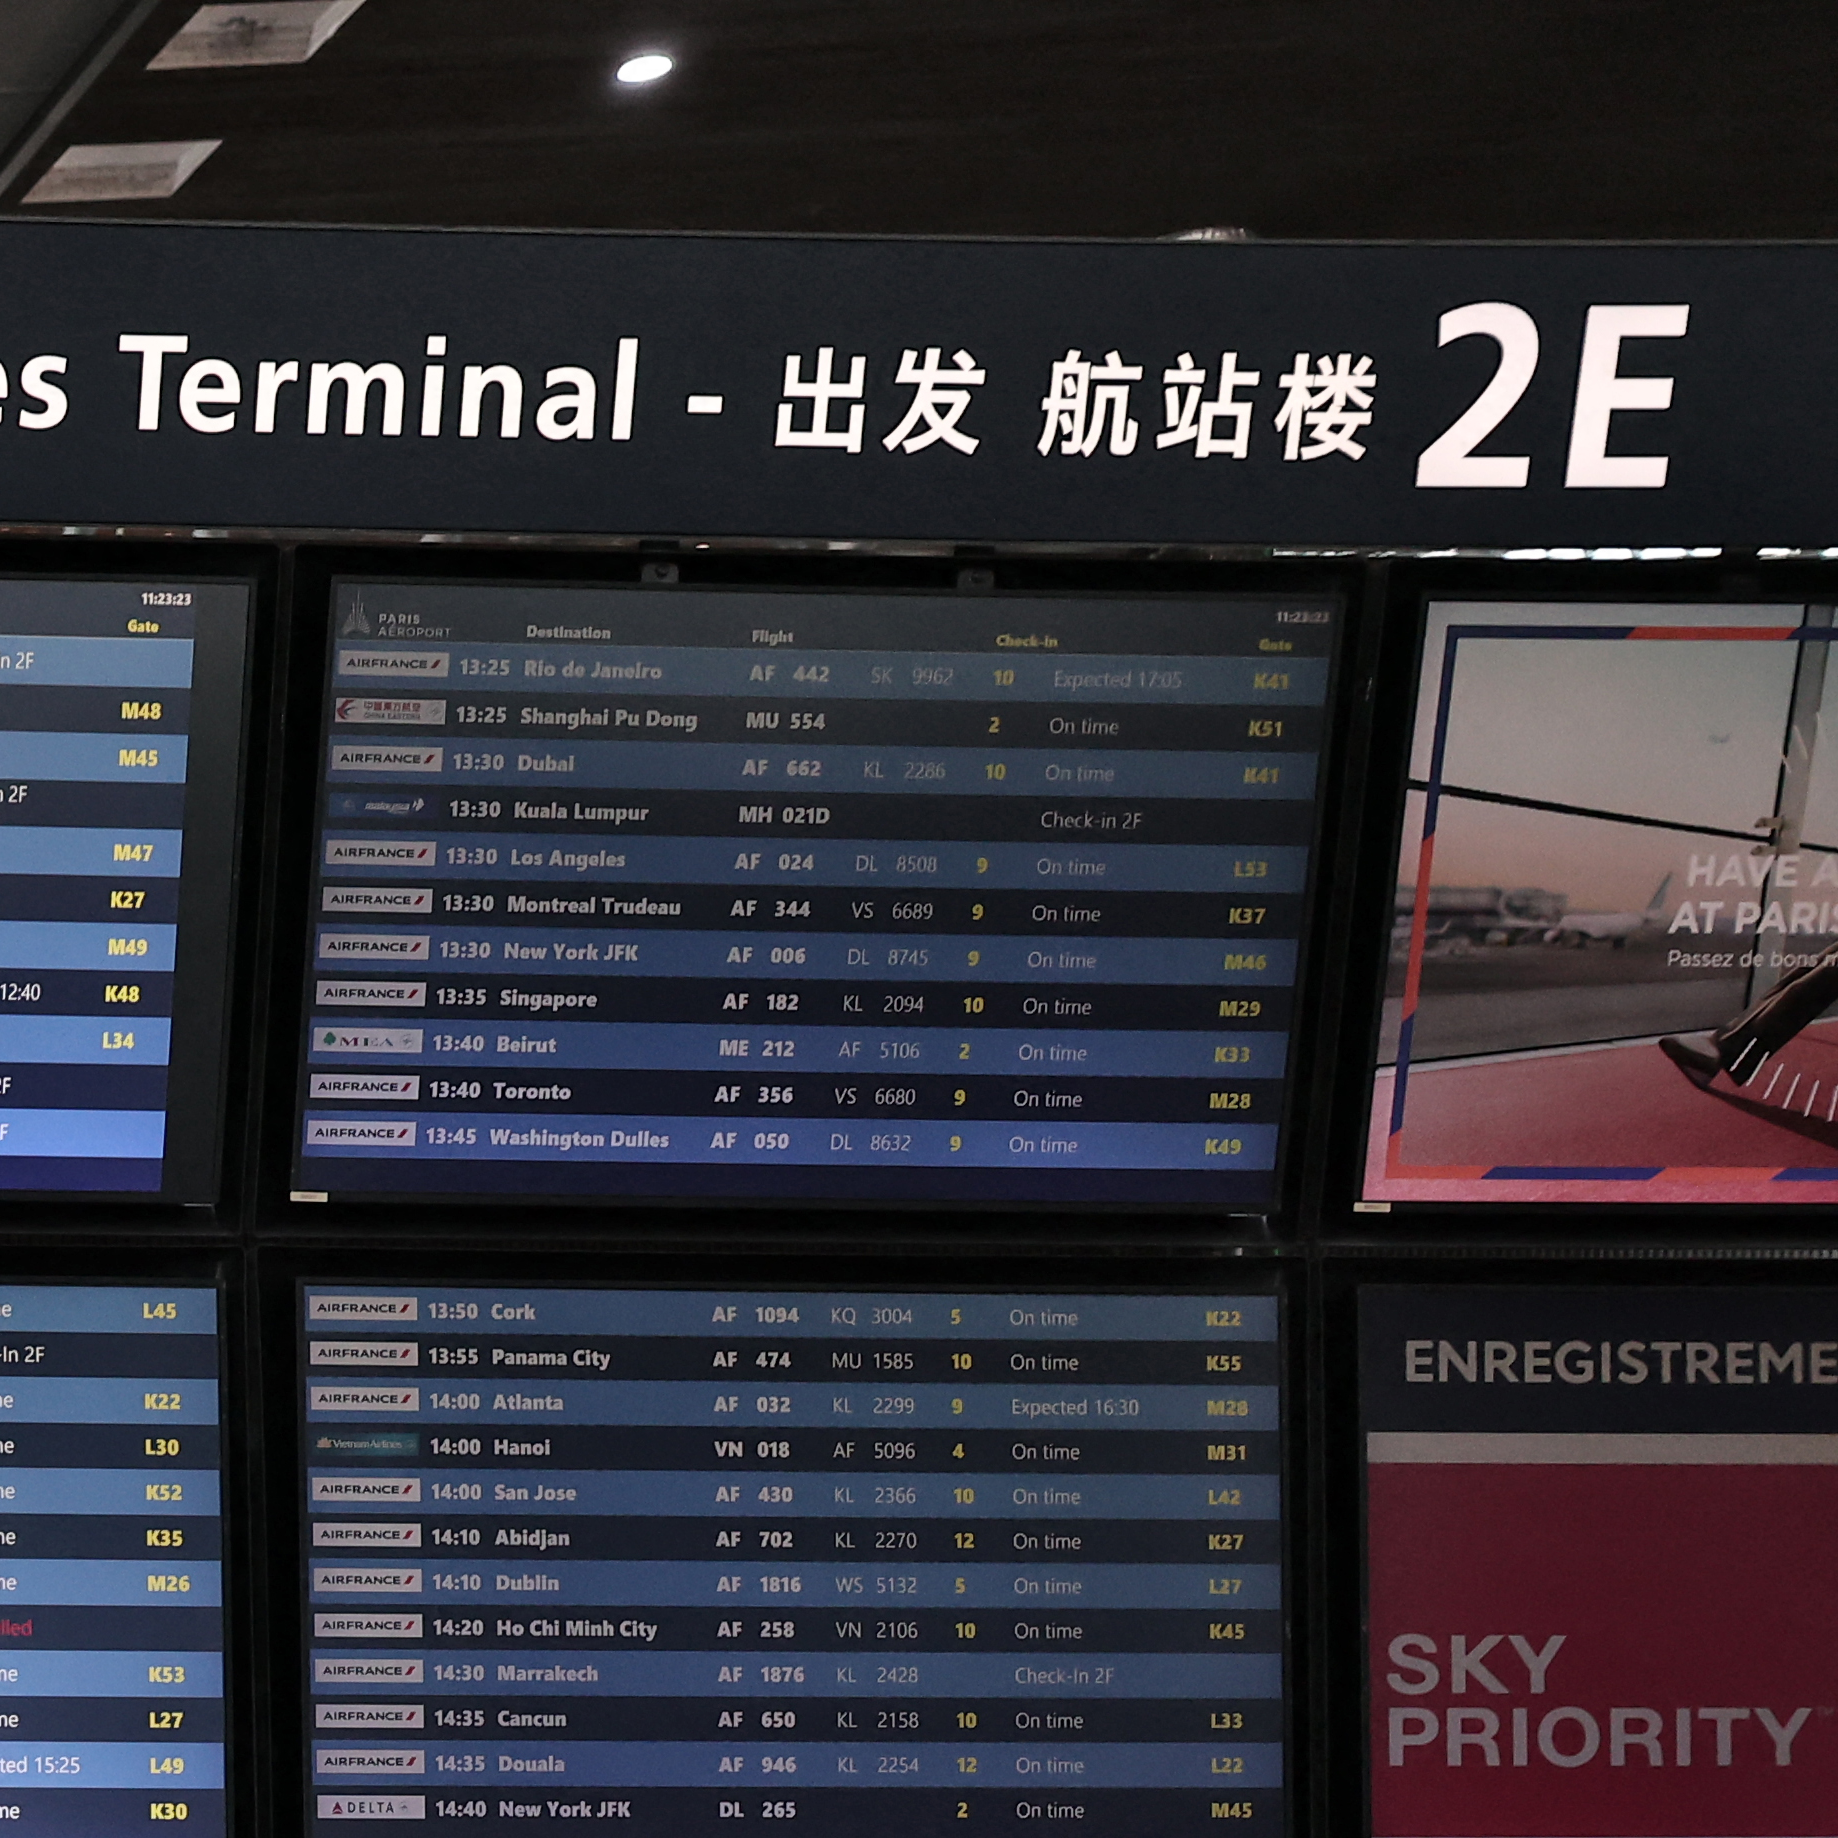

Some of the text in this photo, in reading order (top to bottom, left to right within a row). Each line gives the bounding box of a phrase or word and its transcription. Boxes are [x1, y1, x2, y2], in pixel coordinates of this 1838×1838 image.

[118, 334, 639, 440] Terminal
[774, 347, 986, 455] 出发
[1037, 349, 1377, 461] 航站楼
[1415, 302, 1690, 488] 2E
[449, 799, 1142, 830] 13:30 Kuala Lumpur MH 021D Check-in 2F
[1687, 853, 1801, 888] HAVE
[1666, 900, 1725, 935] AT
[102, 1031, 135, 1050] L34
[320, 1528, 1244, 1551] AIRFRANCE 14:10 Abidjan AF 702 KL 2270 12 On time K27
[1386, 1633, 1567, 1696] SKY
[1388, 1706, 1813, 1768] PRIORITY
